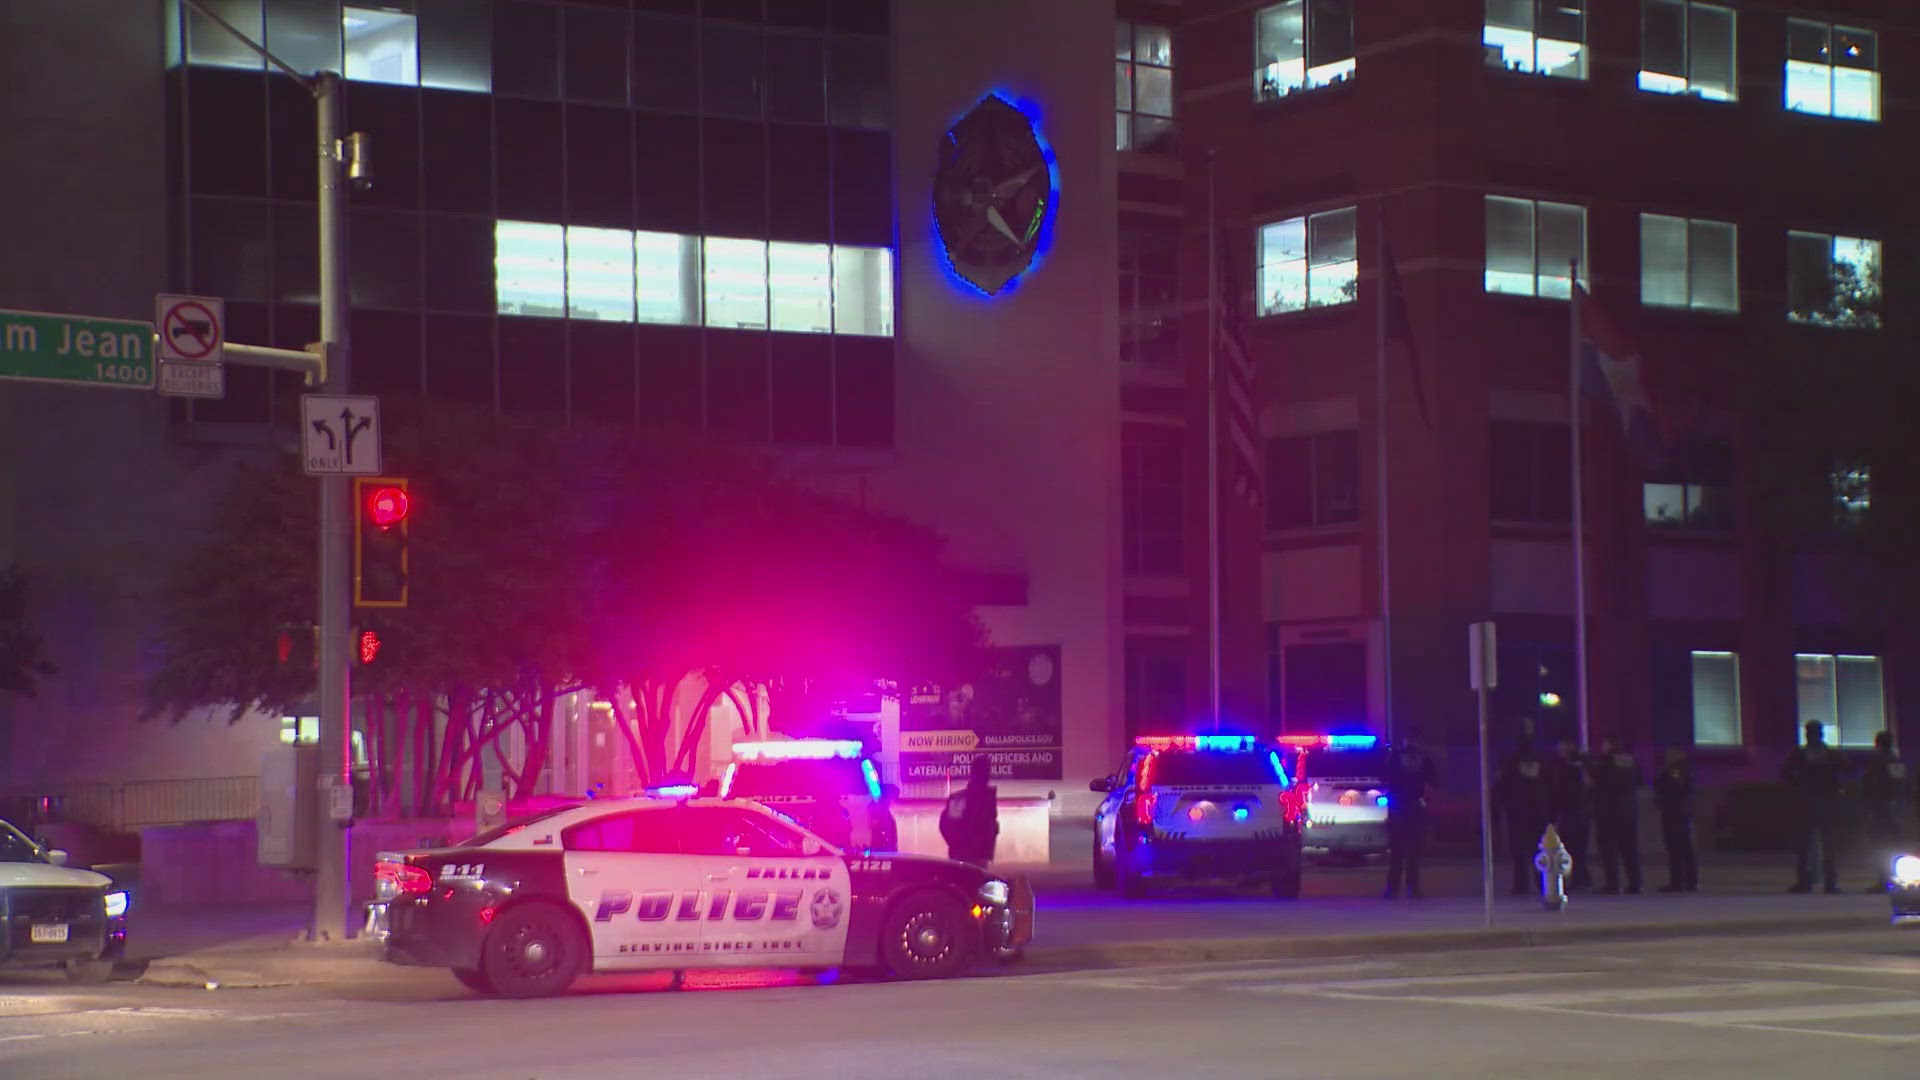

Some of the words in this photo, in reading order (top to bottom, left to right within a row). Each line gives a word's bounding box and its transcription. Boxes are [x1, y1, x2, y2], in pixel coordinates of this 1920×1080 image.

[57, 323, 141, 360] Jean
[96, 363, 147, 382] 1400
[310, 456, 340, 470] ONLY
[908, 736, 933, 747] NOW
[936, 735, 975, 746] HIRING!
[985, 735, 1053, 745] DALLASPOLICE.GOV
[1031, 752, 1053, 763] AND
[991, 765, 1013, 775] LICE
[746, 867, 832, 879] DALLAS
[594, 888, 803, 922] POLICE
[619, 943, 695, 953] SERVING
[703, 941, 754, 950] SINCE
